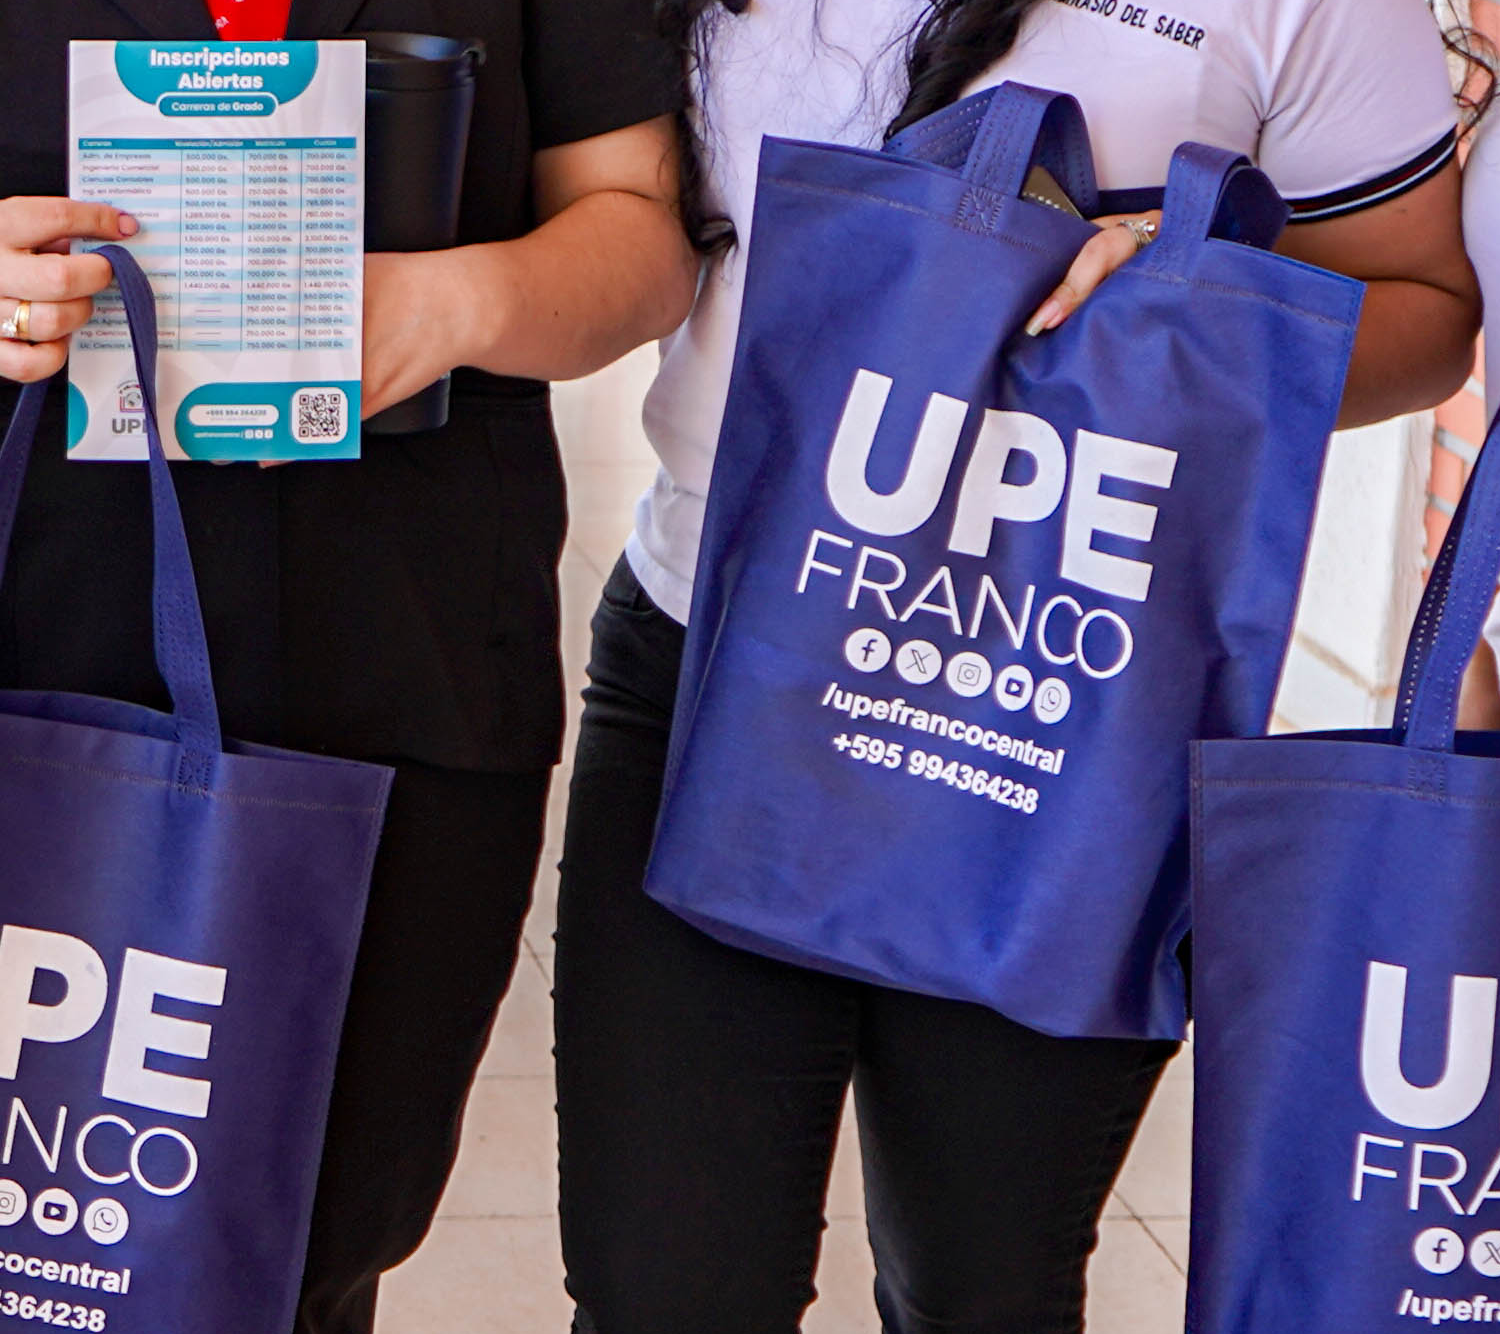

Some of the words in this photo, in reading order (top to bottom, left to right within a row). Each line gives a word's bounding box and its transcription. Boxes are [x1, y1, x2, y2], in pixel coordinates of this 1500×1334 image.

[149, 48, 290, 71] Inscripciones
[1120, 3, 1147, 29] DEL
[1153, 15, 1206, 51] SABER
[171, 101, 216, 113] Carreras
[217, 101, 231, 113] de
[232, 101, 264, 113] Grado
[177, 72, 264, 90] Abiertas
[826, 368, 1178, 602] UPE
[796, 529, 1133, 679] FRANCO
[822, 683, 1066, 776] /upefrancocentral
[833, 732, 903, 770] +595
[907, 749, 1039, 815] 994364238
